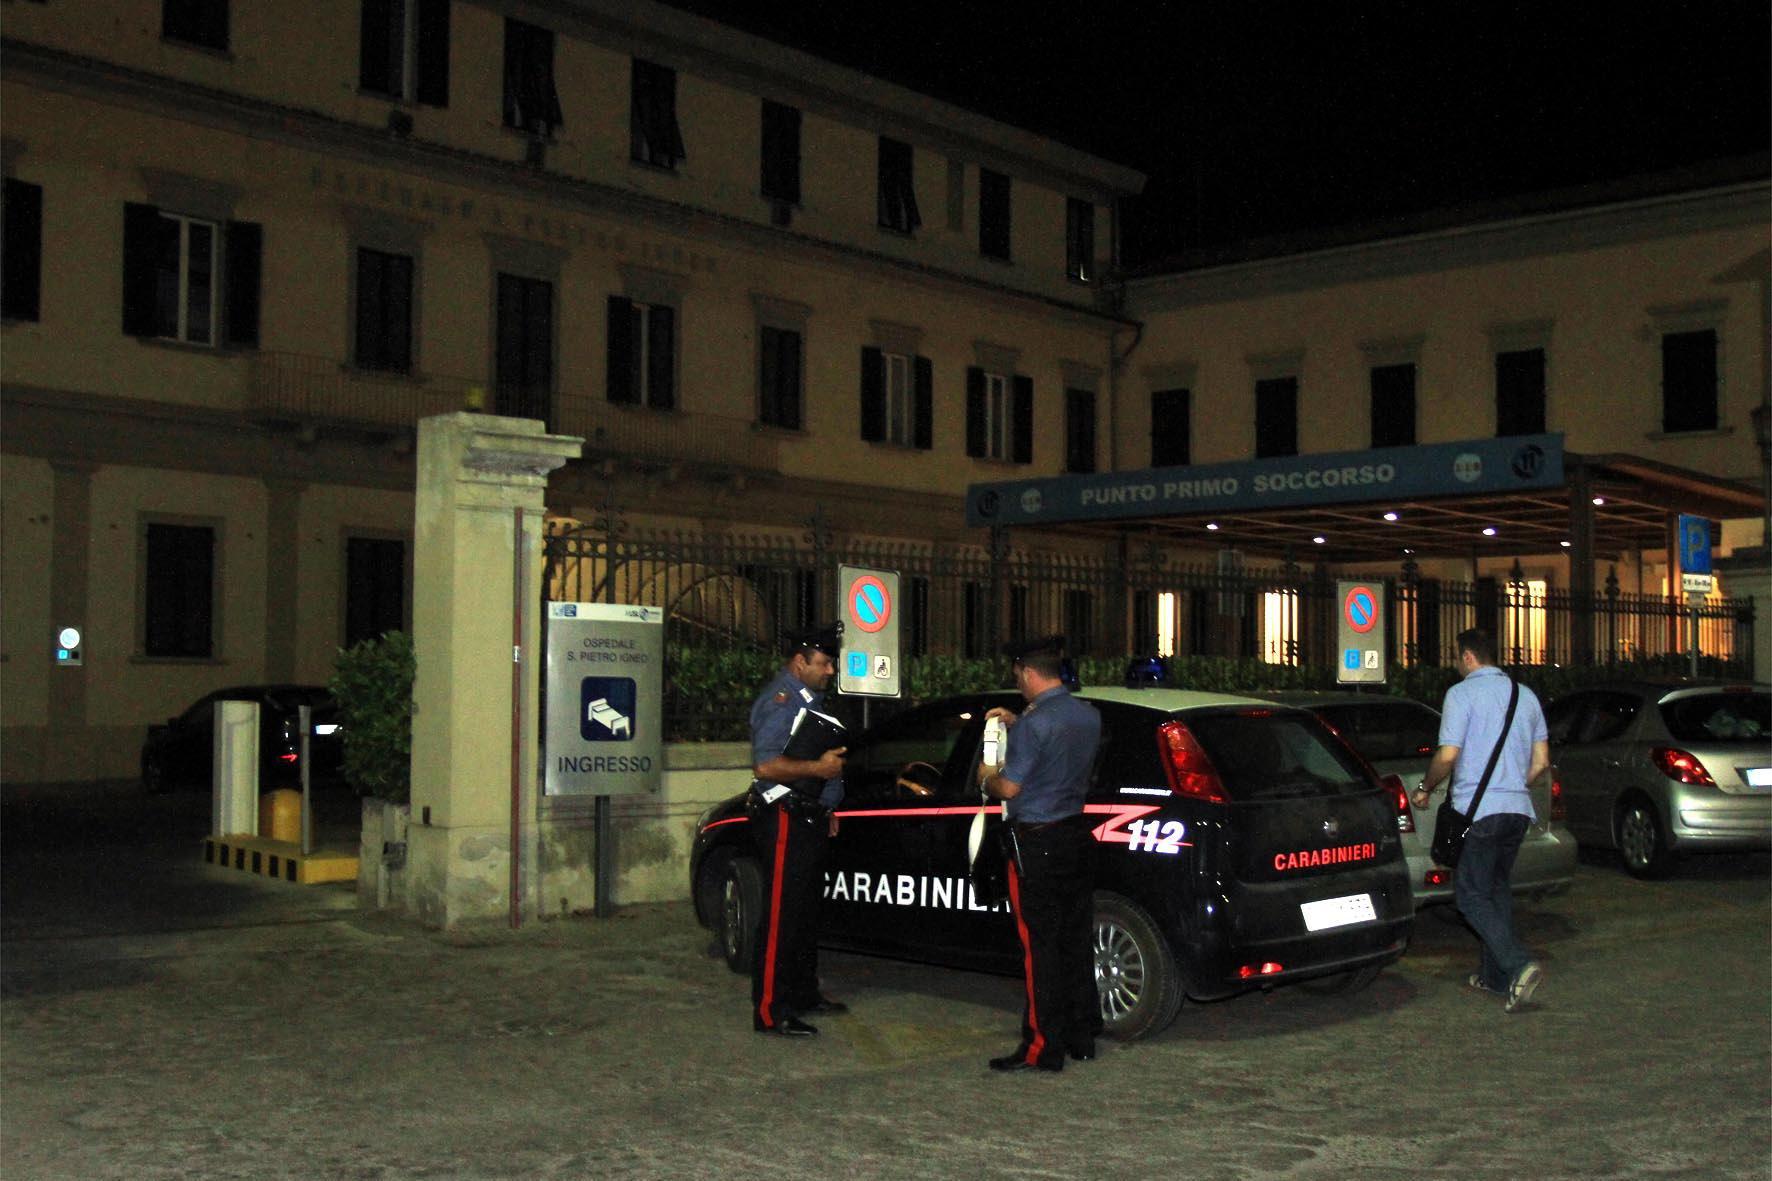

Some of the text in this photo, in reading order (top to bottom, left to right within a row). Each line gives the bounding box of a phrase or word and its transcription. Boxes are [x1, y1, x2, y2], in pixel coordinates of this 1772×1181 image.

[1081, 463, 1395, 505] PUNTO PRIMO SOCCORSO
[1687, 523, 1704, 566] P
[567, 651, 649, 663] S. PIETRO IGNEO
[583, 638, 635, 649] OSPEDALE
[852, 655, 864, 673] P
[558, 756, 652, 773] INGRESSO
[1127, 819, 1185, 854] 112
[1274, 842, 1375, 871] CARABINIERI
[823, 871, 1011, 912] ARABINI
